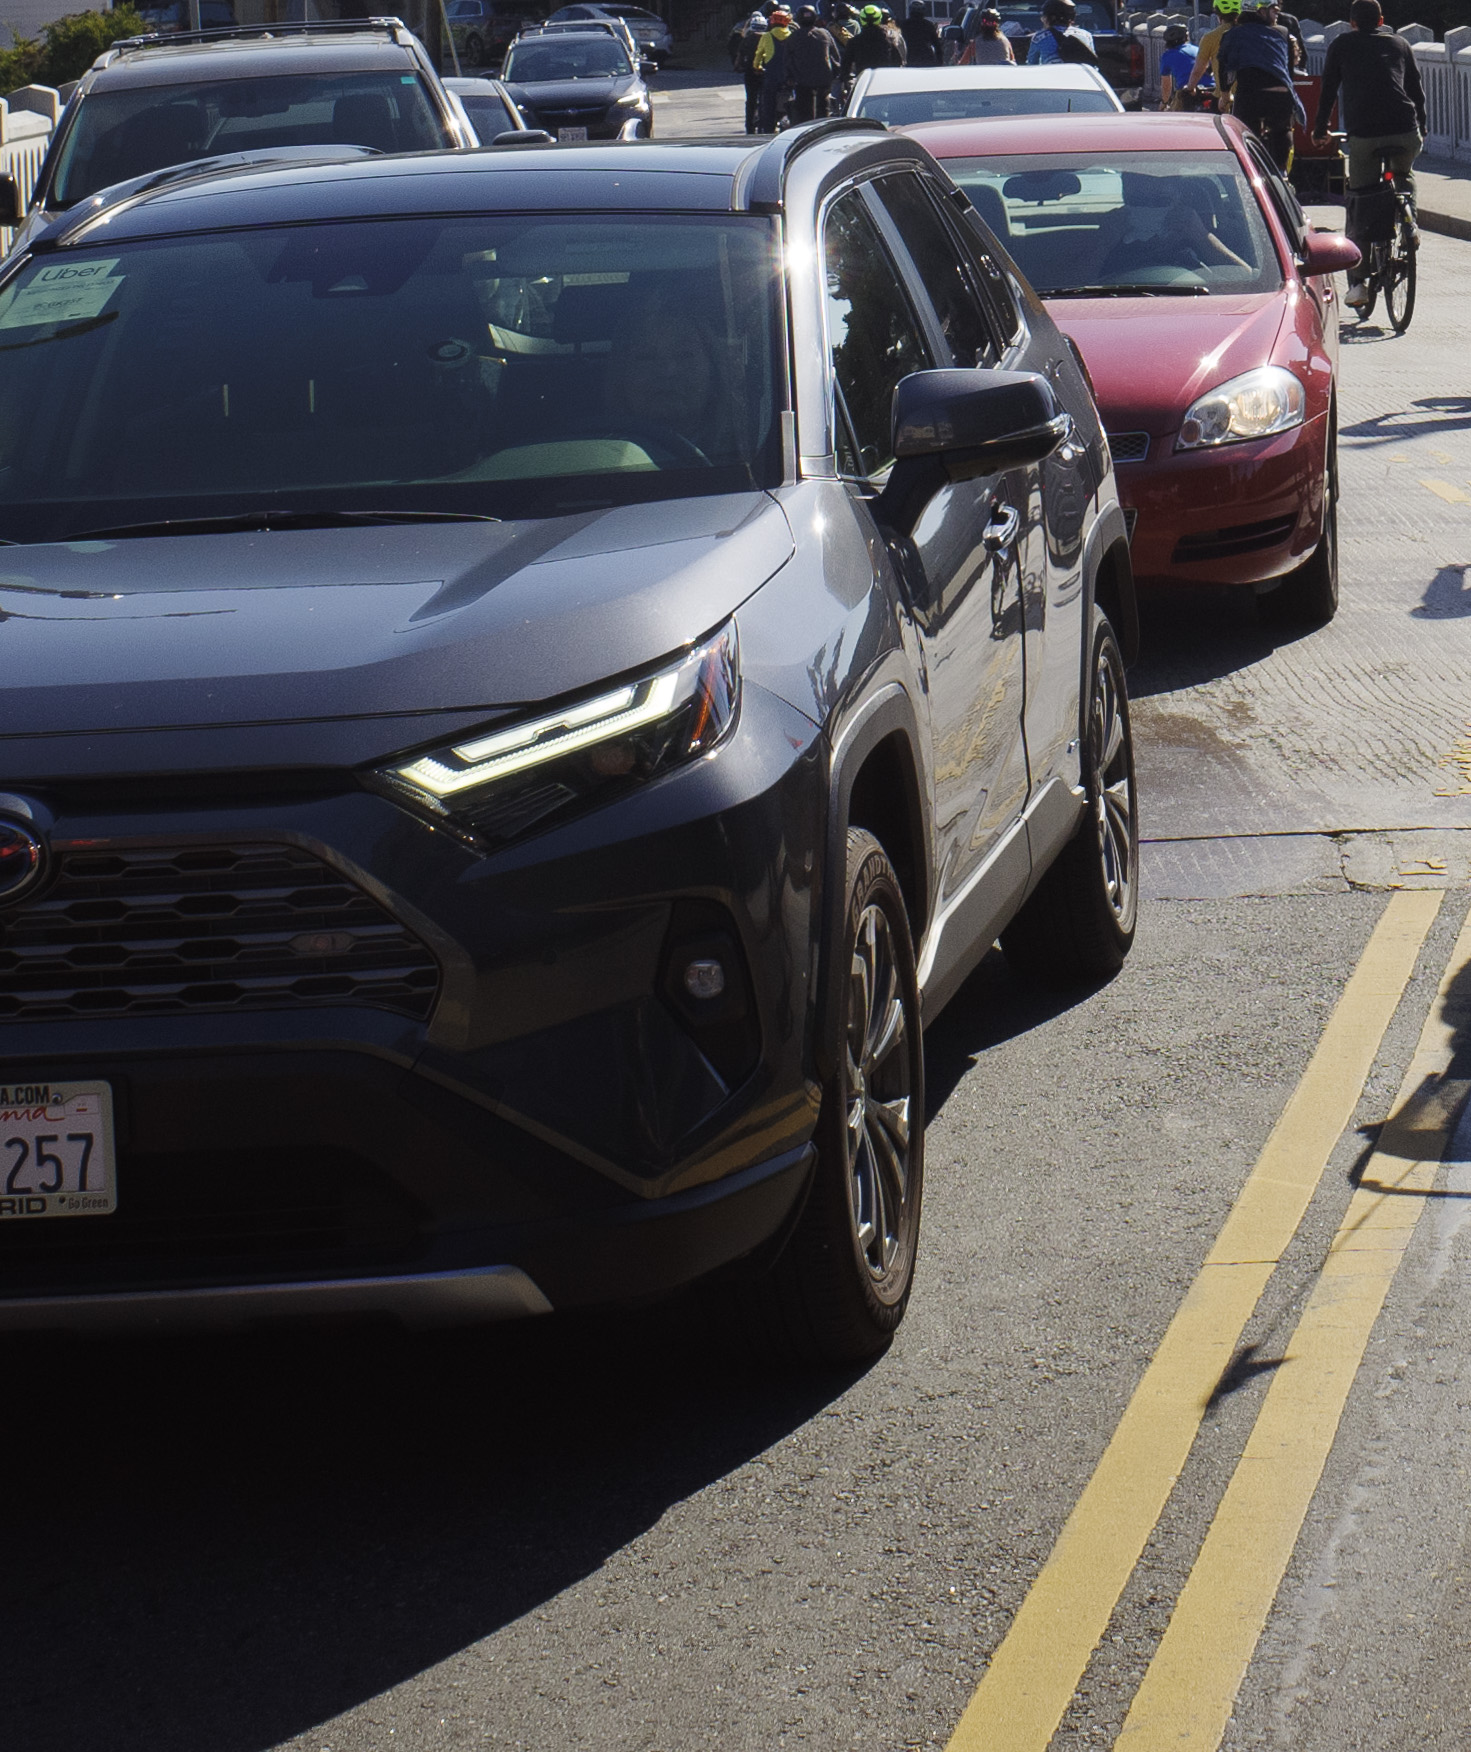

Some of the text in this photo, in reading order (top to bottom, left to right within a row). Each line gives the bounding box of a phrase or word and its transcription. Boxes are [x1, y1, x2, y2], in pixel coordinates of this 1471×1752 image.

[41, 266, 107, 282] Uber
[68, 1198, 81, 1209] Go
[81, 1196, 108, 1209] Green
